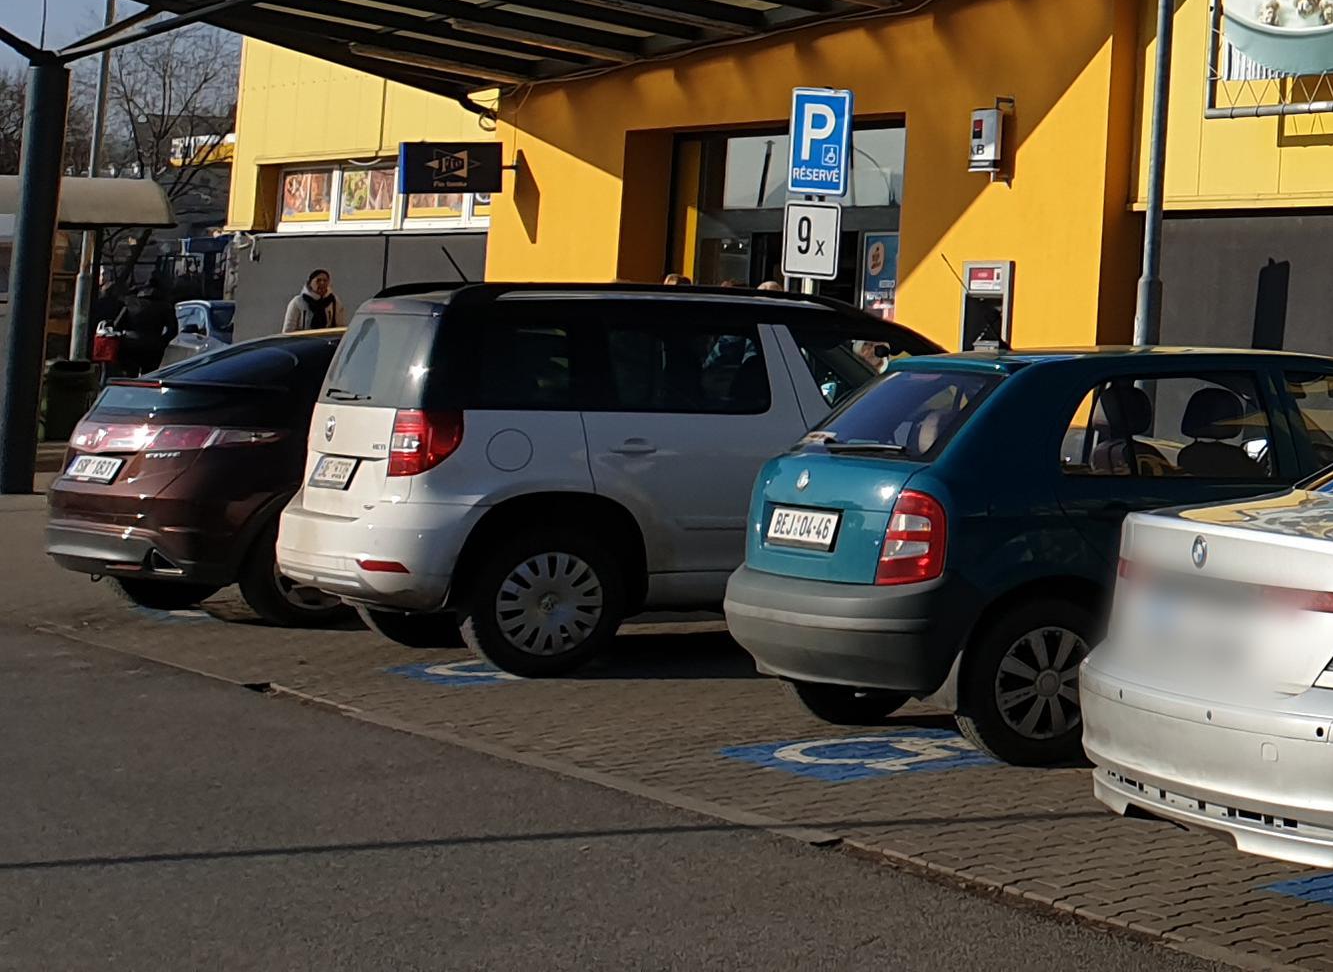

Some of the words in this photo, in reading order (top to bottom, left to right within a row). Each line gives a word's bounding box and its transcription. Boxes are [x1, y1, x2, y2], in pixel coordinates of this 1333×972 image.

[800, 102, 837, 161] P
[792, 165, 840, 184] RÉSERVÉ
[796, 215, 812, 256] 9
[773, 512, 796, 534] BEJ
